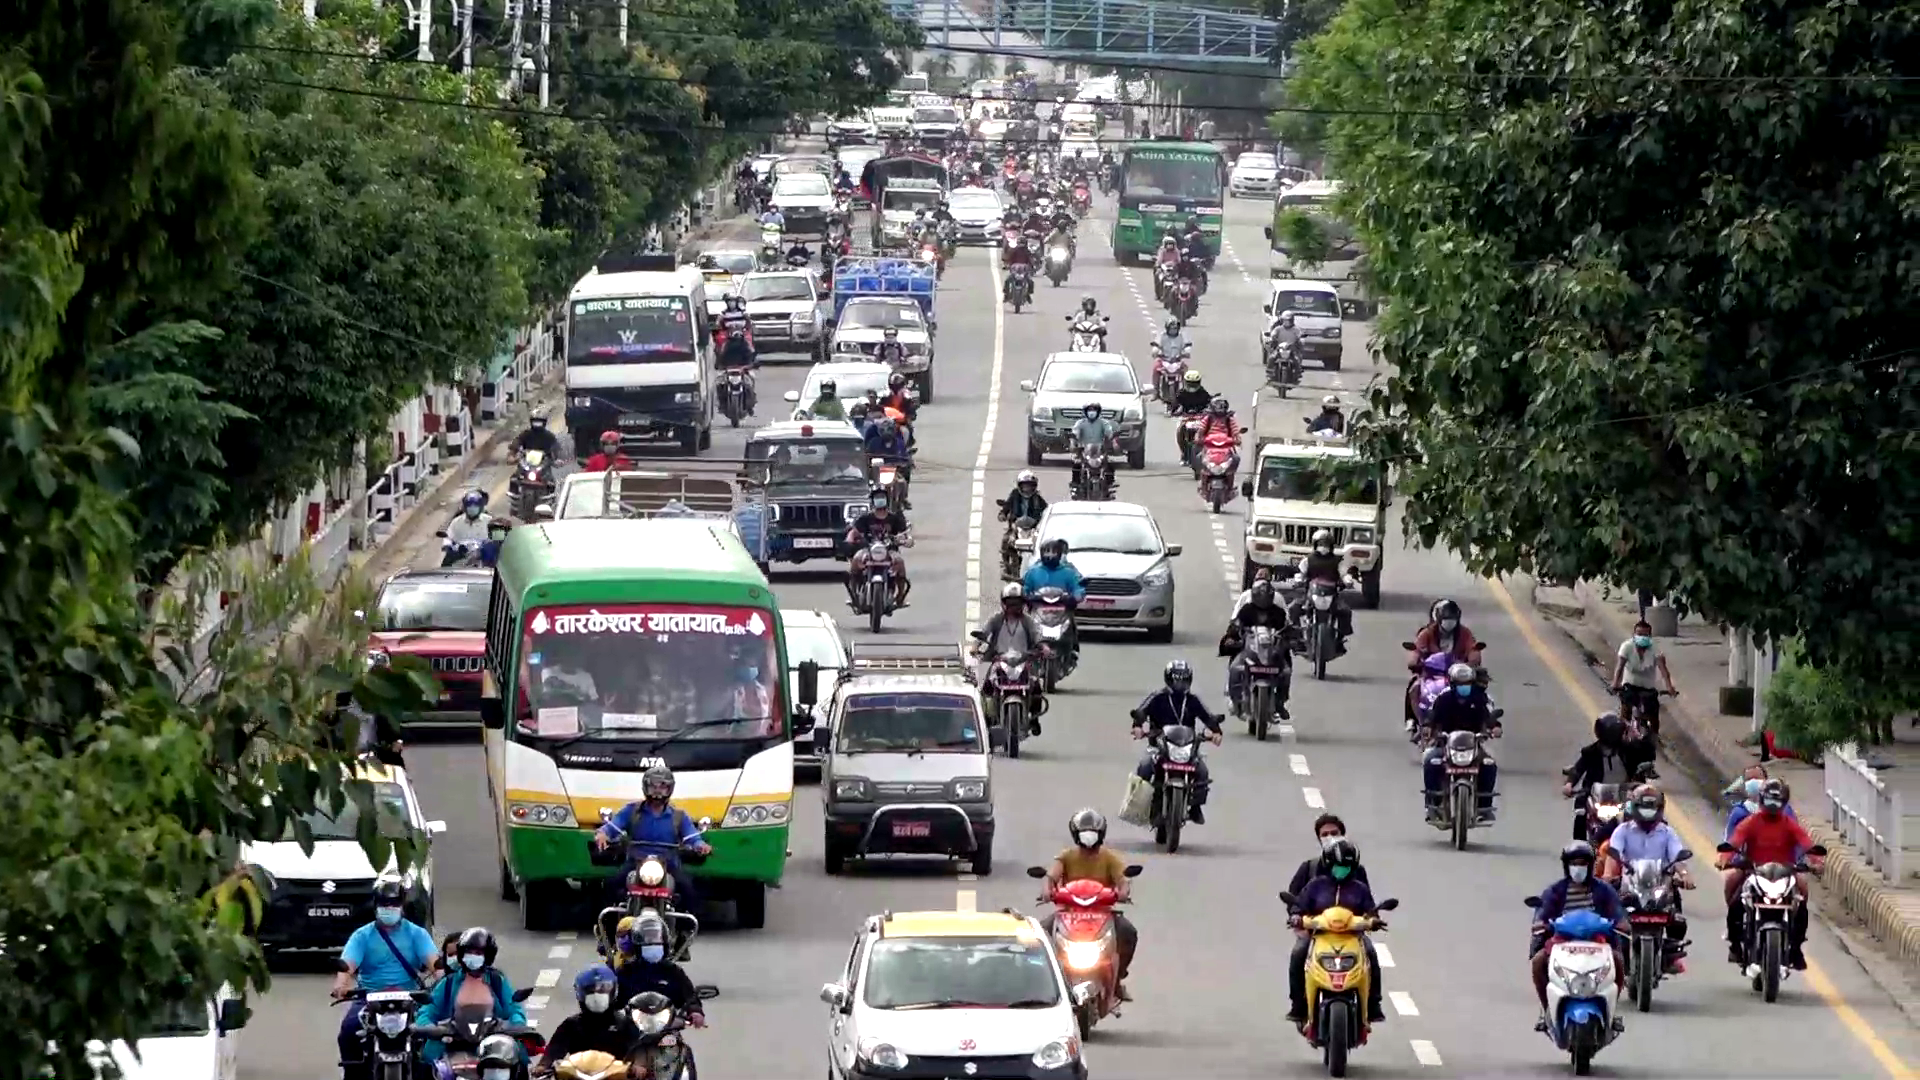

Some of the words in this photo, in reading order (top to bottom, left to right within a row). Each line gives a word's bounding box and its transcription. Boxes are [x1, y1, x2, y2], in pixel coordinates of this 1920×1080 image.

[624, 299, 669, 309] यातायात
[554, 609, 645, 634] तारकेश्वर
[647, 612, 727, 634] यातायात
